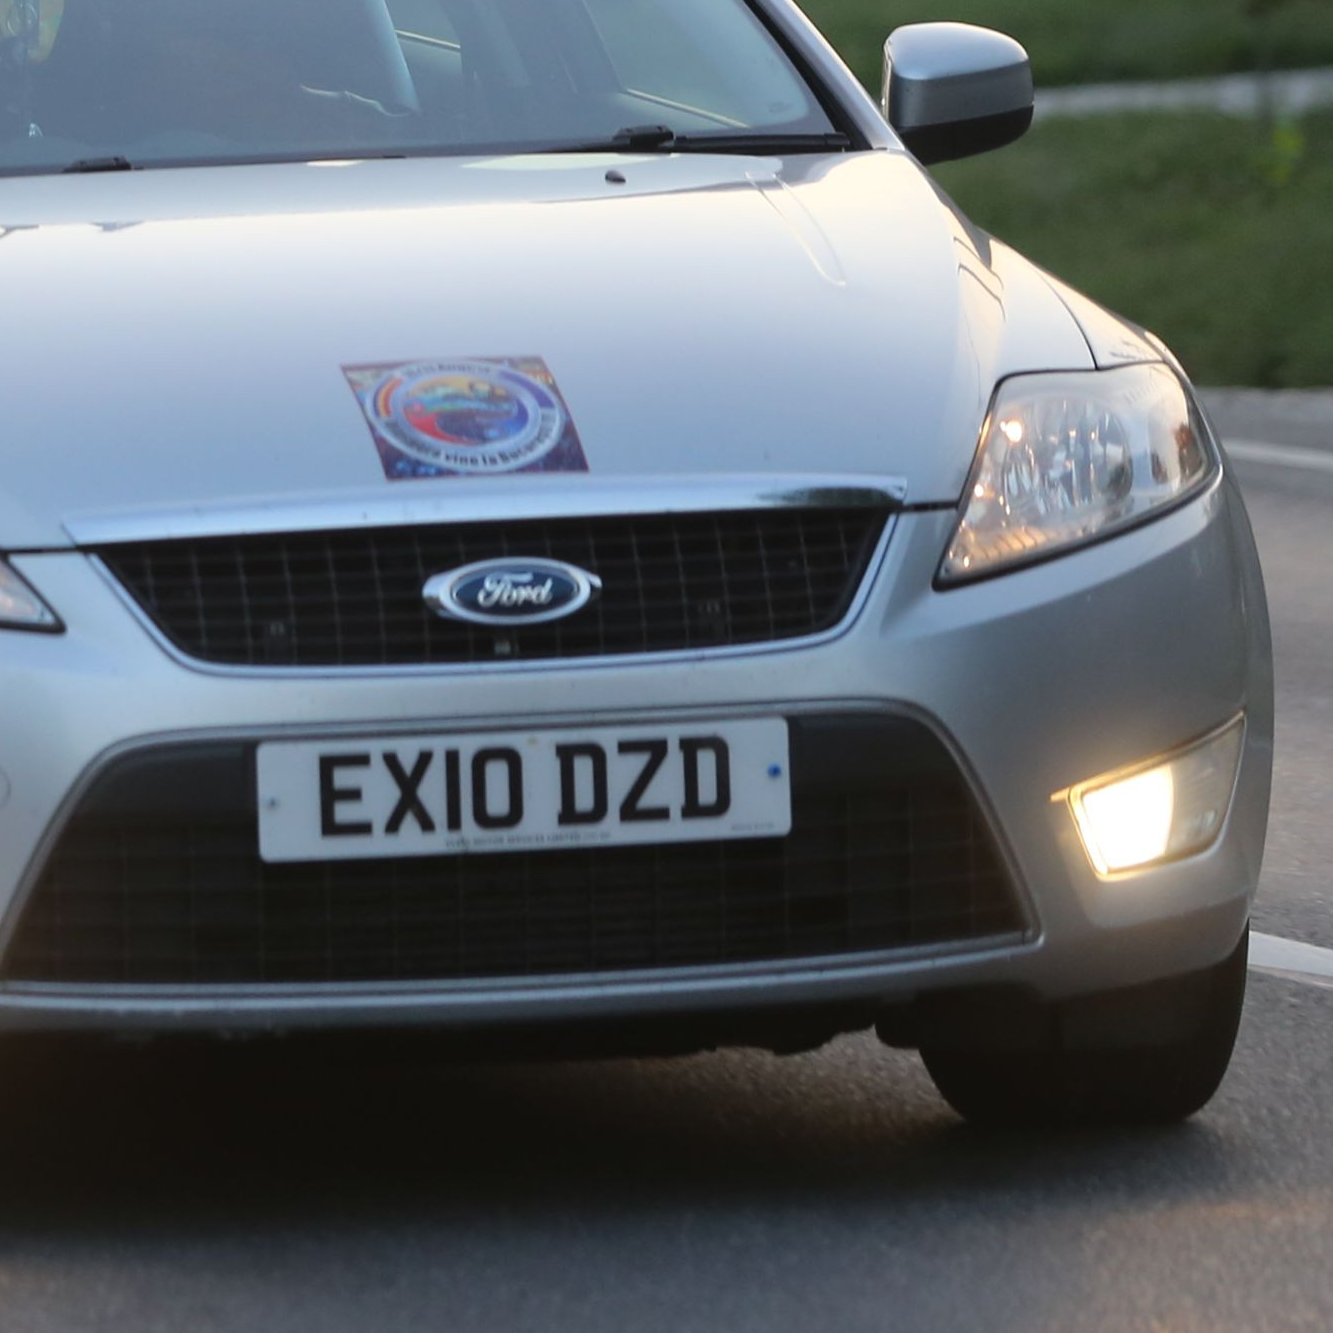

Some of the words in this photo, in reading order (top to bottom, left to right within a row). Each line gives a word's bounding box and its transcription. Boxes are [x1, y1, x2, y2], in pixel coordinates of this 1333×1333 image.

[477, 572, 553, 608] Ford
[318, 746, 524, 838] EX10
[555, 735, 732, 827] DZD
